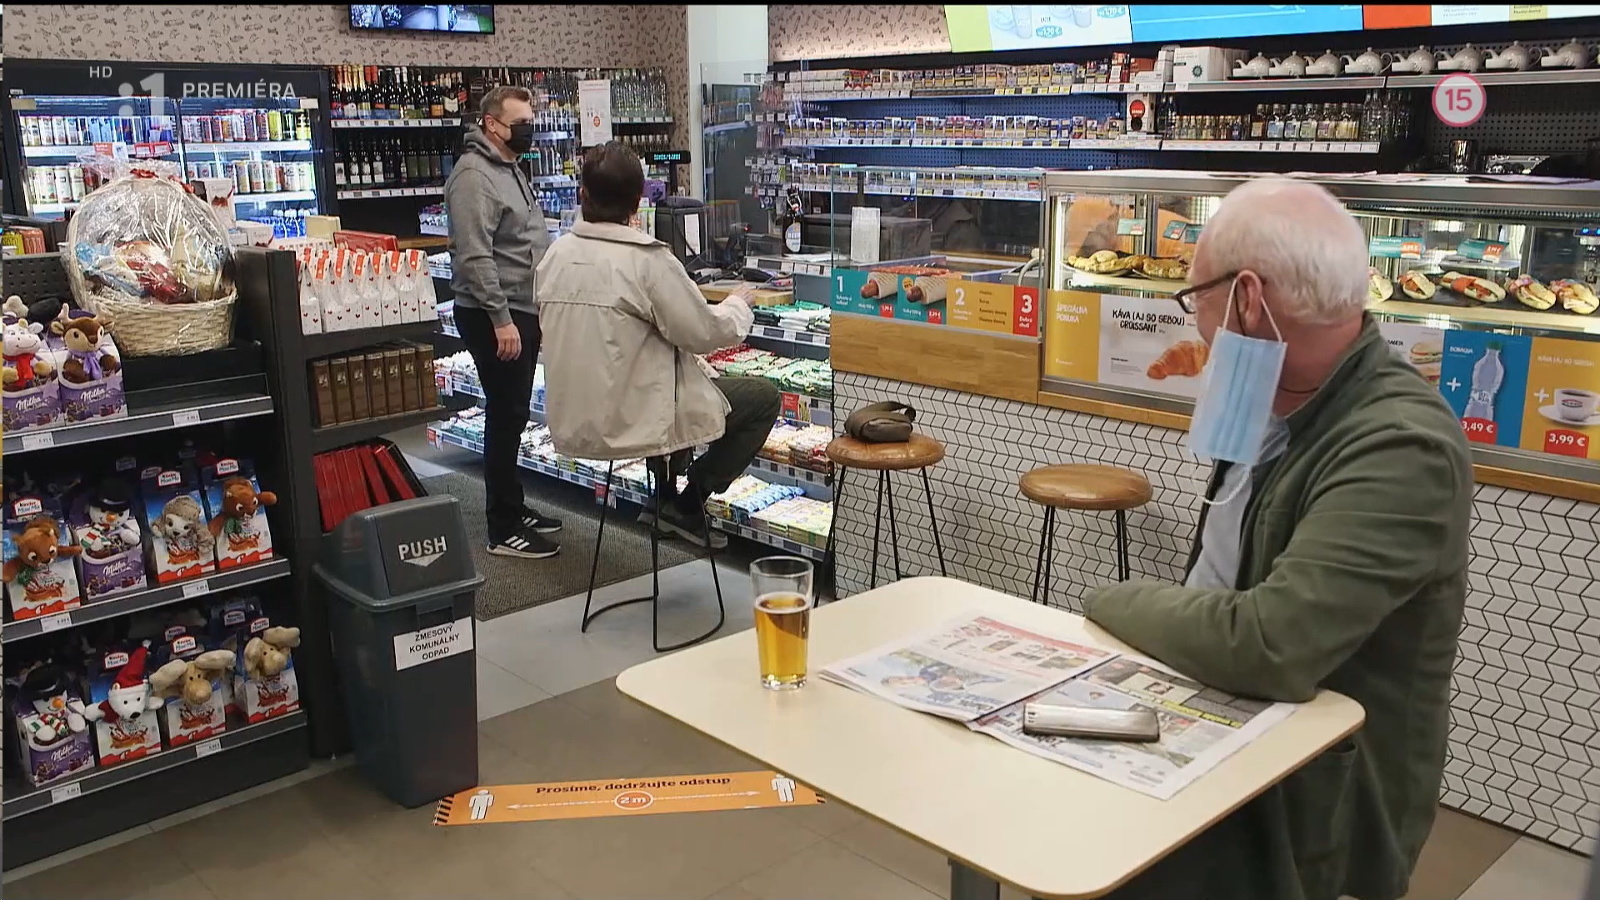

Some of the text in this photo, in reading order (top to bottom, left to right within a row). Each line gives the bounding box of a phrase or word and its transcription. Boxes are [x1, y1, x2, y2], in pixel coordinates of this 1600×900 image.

[836, 275, 844, 293] 1
[955, 287, 966, 306] 2
[1020, 294, 1033, 314] 3
[1112, 307, 1131, 320] KÁVA
[1146, 313, 1157, 323] SO
[1158, 315, 1185, 326] SEBOU)
[1119, 320, 1158, 334] CROISSANT
[16, 395, 42, 411] Milka
[80, 387, 106, 403] Milka
[1461, 420, 1494, 434] 3,49 €
[1549, 433, 1586, 447] 3,99 €
[397, 535, 448, 561] PUSH
[415, 624, 454, 641] ZMESOVÝ
[409, 633, 460, 653] KOMUNÁLNY
[421, 646, 450, 660] ODPAD
[536, 776, 731, 794] Prosíme, dodržujte odstup
[619, 795, 647, 805] 2 m
